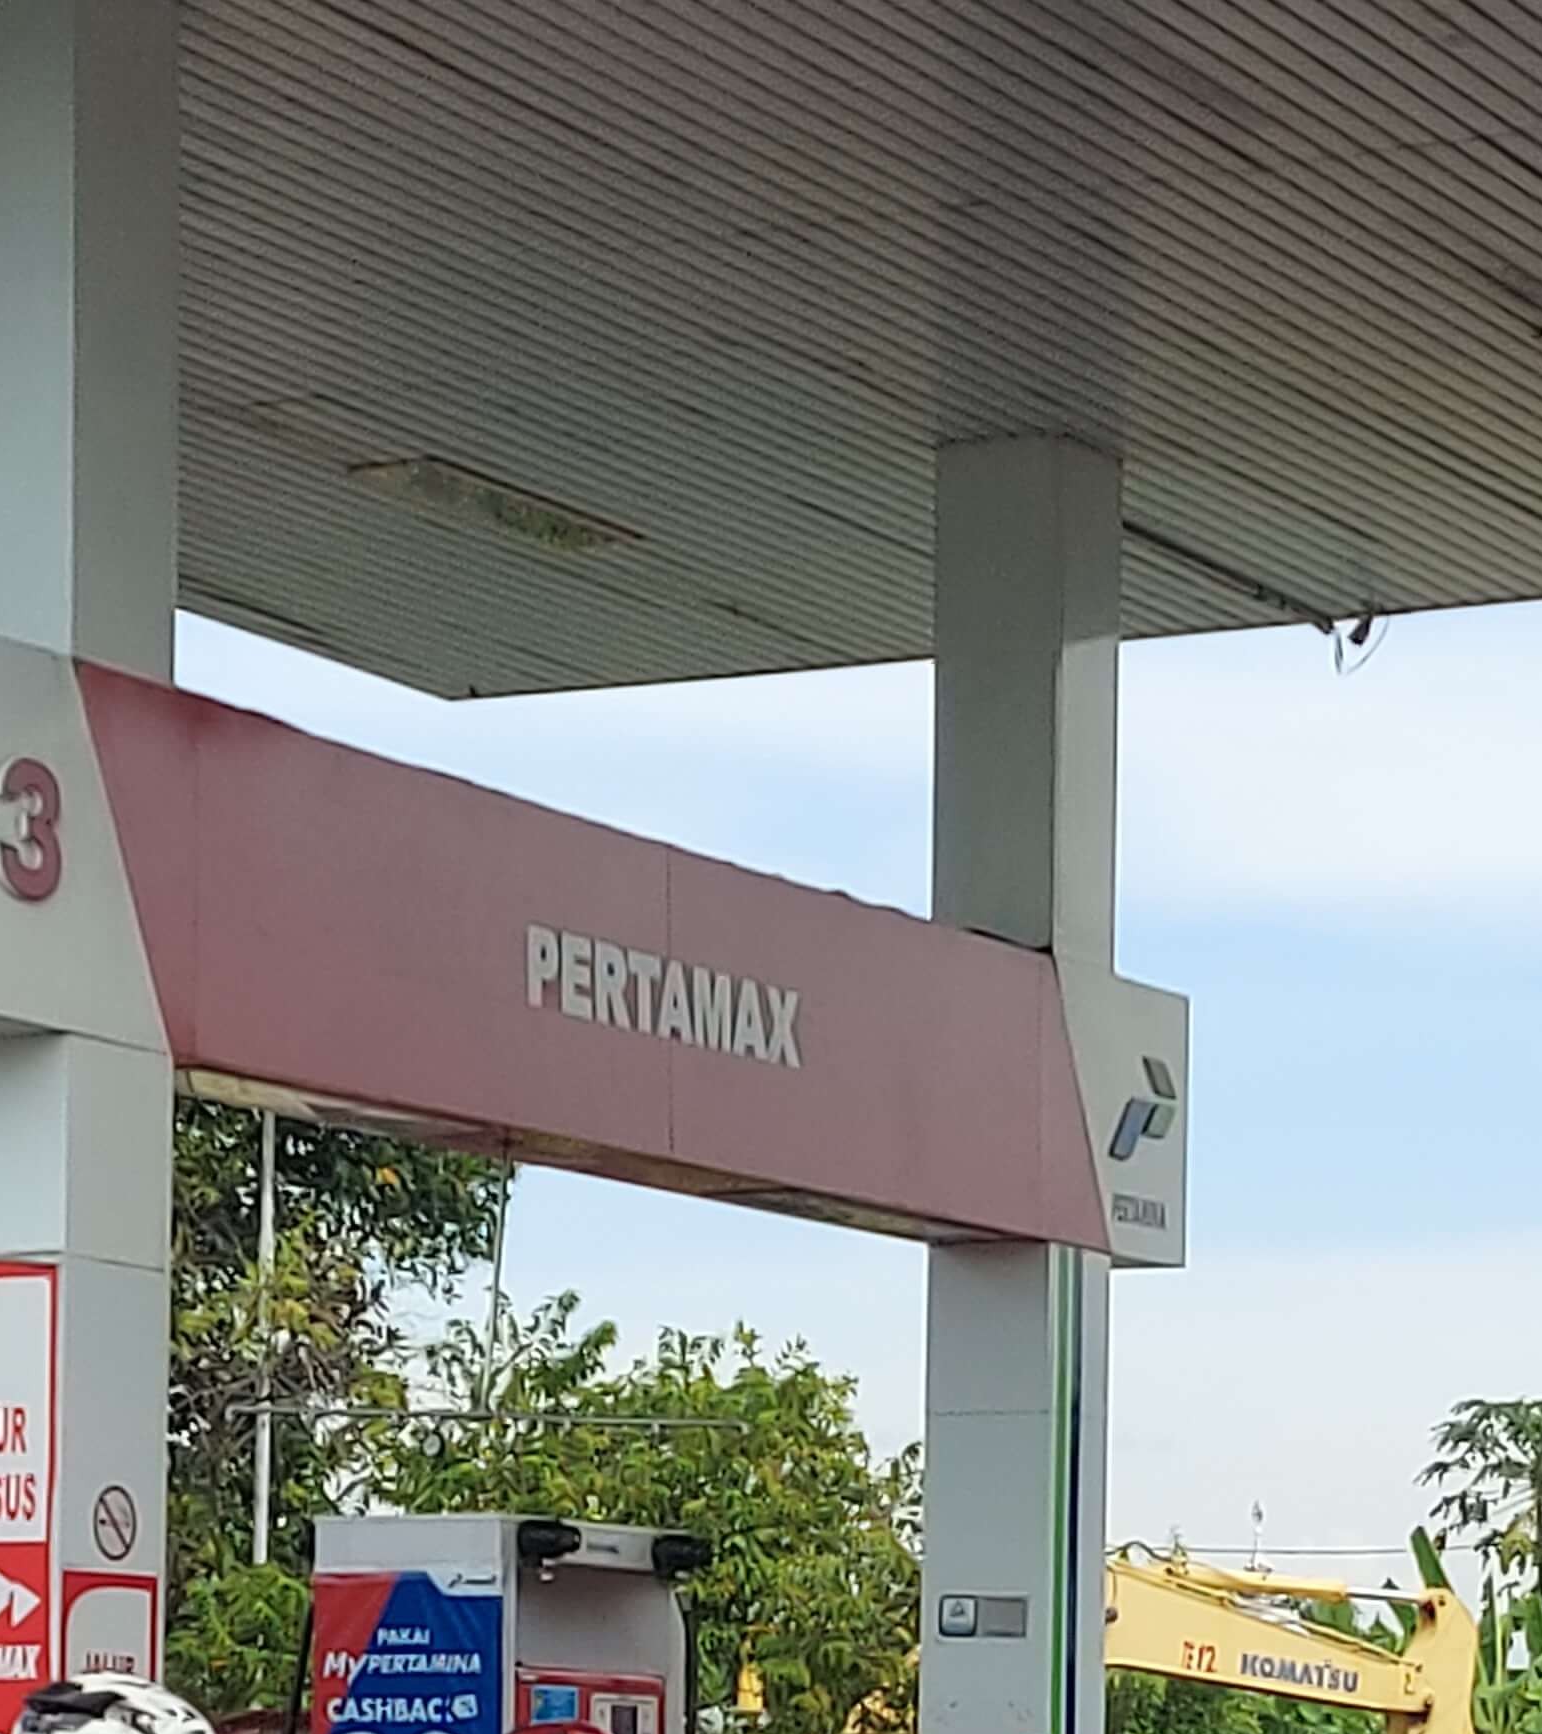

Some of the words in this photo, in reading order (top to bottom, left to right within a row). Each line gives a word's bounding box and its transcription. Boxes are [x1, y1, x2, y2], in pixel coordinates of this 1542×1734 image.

[525, 921, 802, 1069] PERTAMAX
[377, 1626, 430, 1646] PAKAI
[1239, 1653, 1359, 1693] KOMATSU
